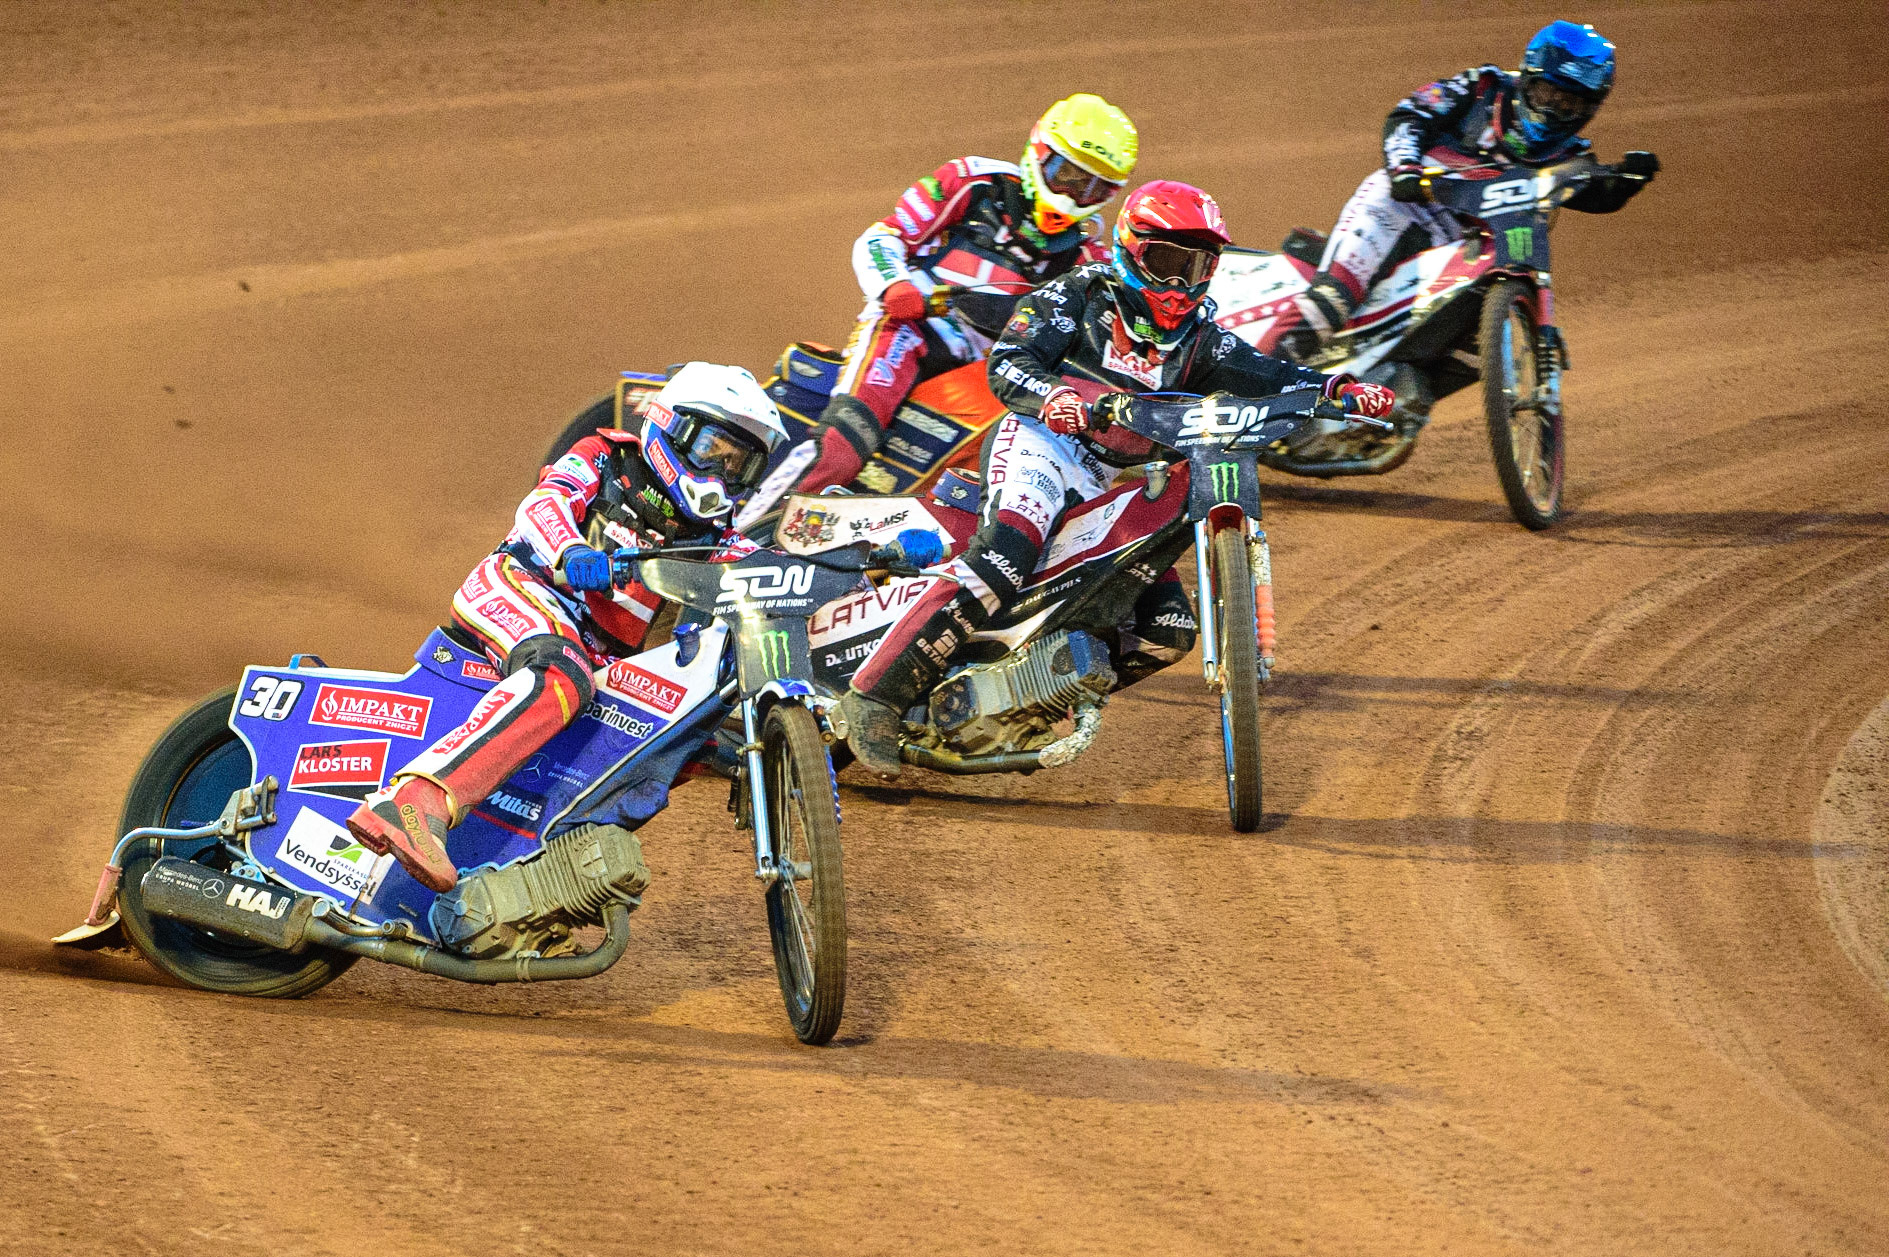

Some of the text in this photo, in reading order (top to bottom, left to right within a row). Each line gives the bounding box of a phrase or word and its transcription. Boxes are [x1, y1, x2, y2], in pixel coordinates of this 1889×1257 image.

[990, 411, 1020, 485] ATVIA
[869, 510, 909, 531] LaMSF
[981, 550, 1023, 590] Aldar
[713, 606, 727, 616] FIM
[766, 600, 776, 608] OF
[810, 580, 929, 635] LATVIA
[240, 675, 304, 722] 30
[623, 669, 681, 704] IMPAKT
[336, 714, 418, 732] PRODUCENT ZNICZY
[340, 696, 423, 722] IMPAKT
[586, 701, 652, 738] parinvest
[298, 756, 372, 774] KLOSTER
[300, 744, 343, 760] LARS
[486, 790, 541, 822] Mitas
[226, 883, 291, 919] HAJ
